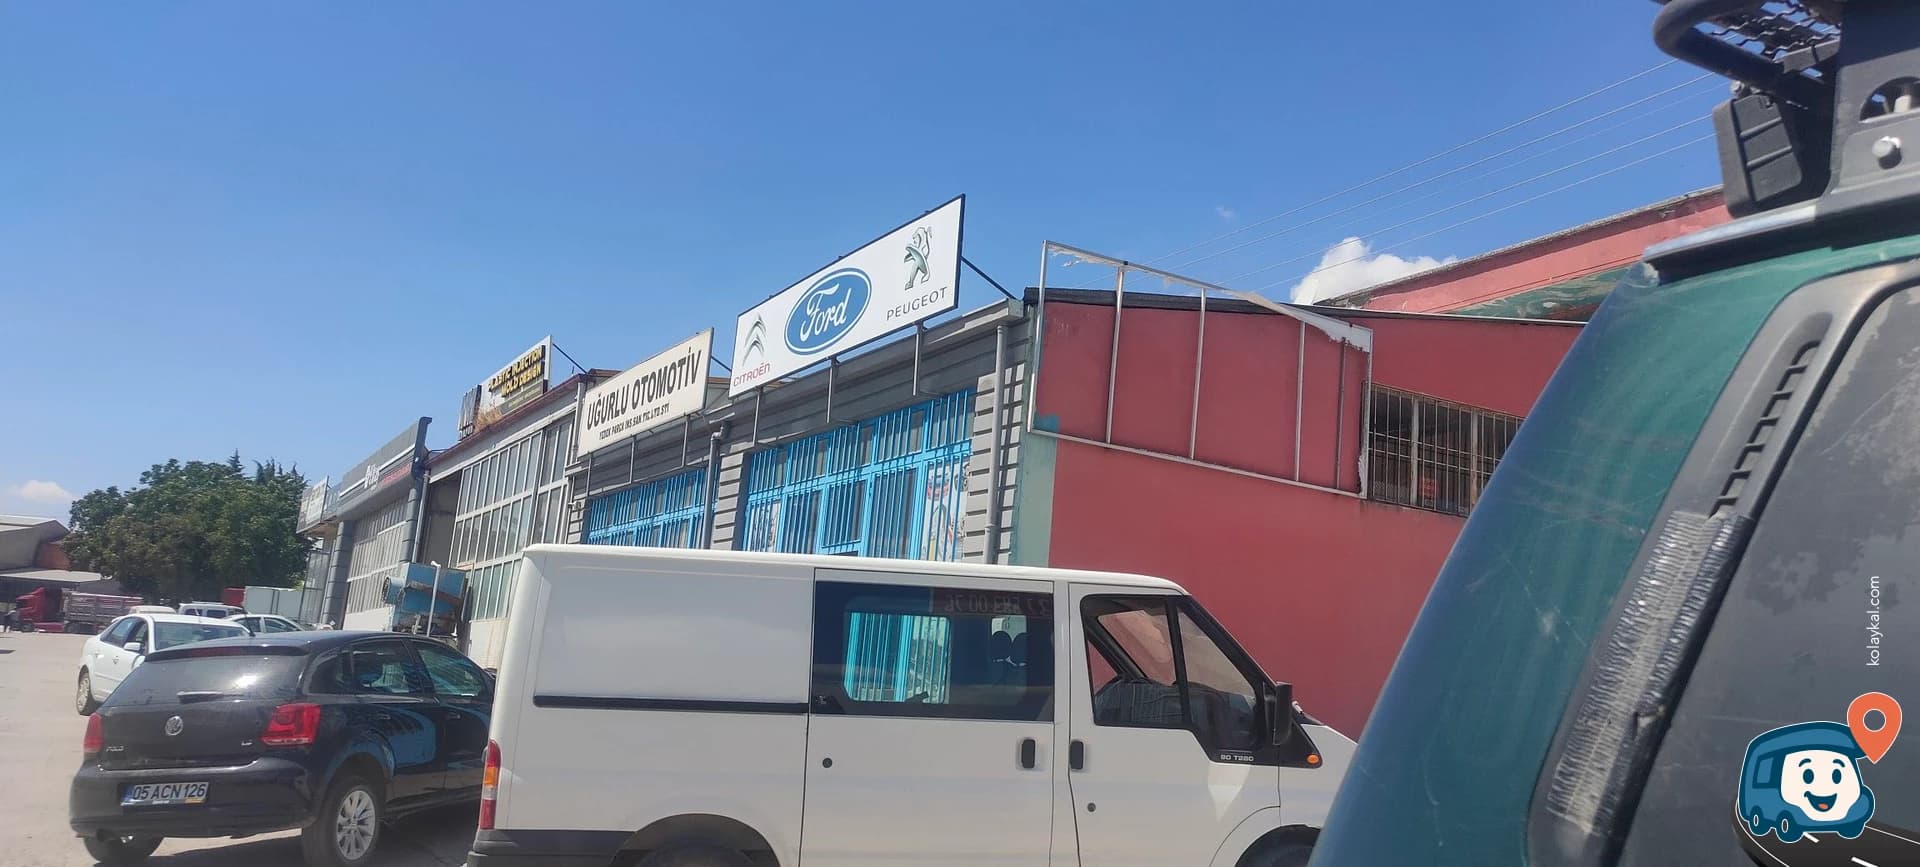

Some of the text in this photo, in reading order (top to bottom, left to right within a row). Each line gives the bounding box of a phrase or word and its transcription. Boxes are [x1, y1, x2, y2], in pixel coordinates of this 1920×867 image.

[799, 283, 852, 342] Ford
[886, 286, 948, 321] PEUGEOT
[587, 346, 702, 431] UĞURLU OTOMOTİV
[133, 783, 206, 800] 05 ACN 126
